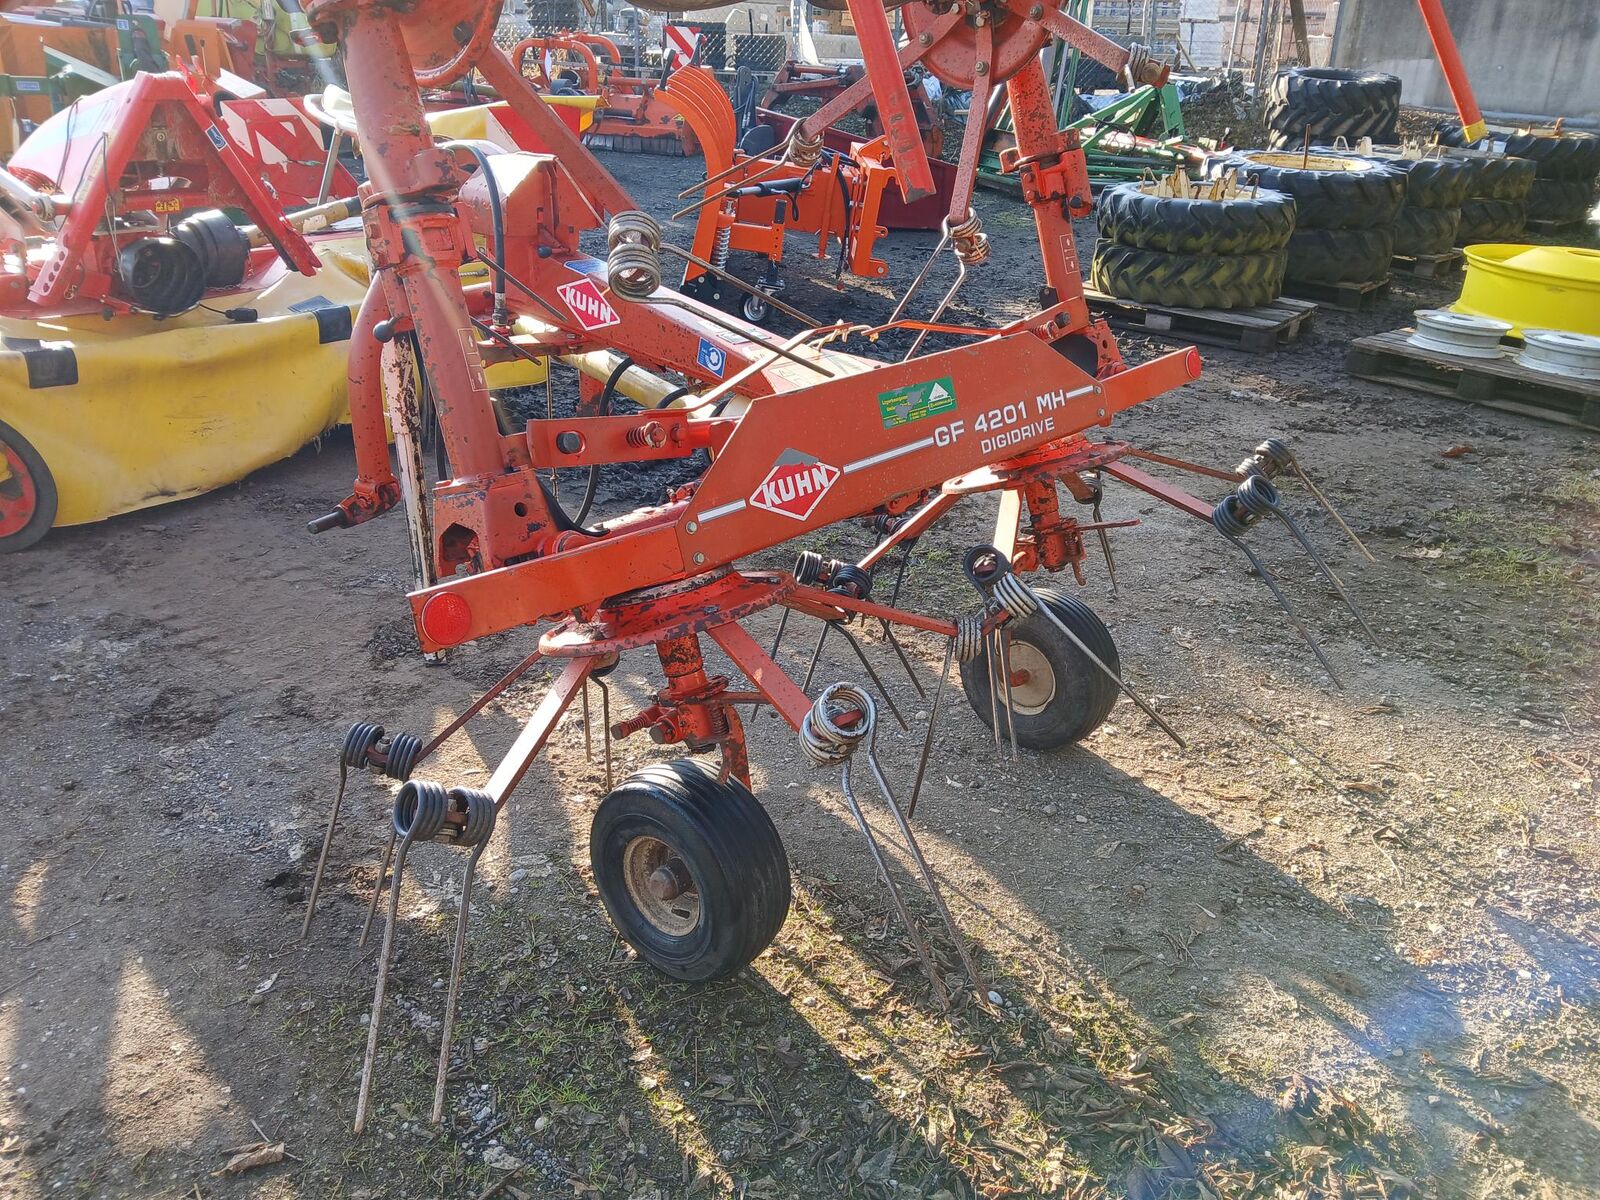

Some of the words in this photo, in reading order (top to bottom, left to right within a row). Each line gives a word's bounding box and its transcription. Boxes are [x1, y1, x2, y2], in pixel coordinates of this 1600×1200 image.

[565, 286, 612, 324] KUHN
[934, 420, 965, 447] GF
[974, 401, 1027, 432] 4201
[1036, 389, 1066, 414] MH
[980, 417, 1055, 454] DIGIDRIVE
[762, 465, 830, 508] KUHN
